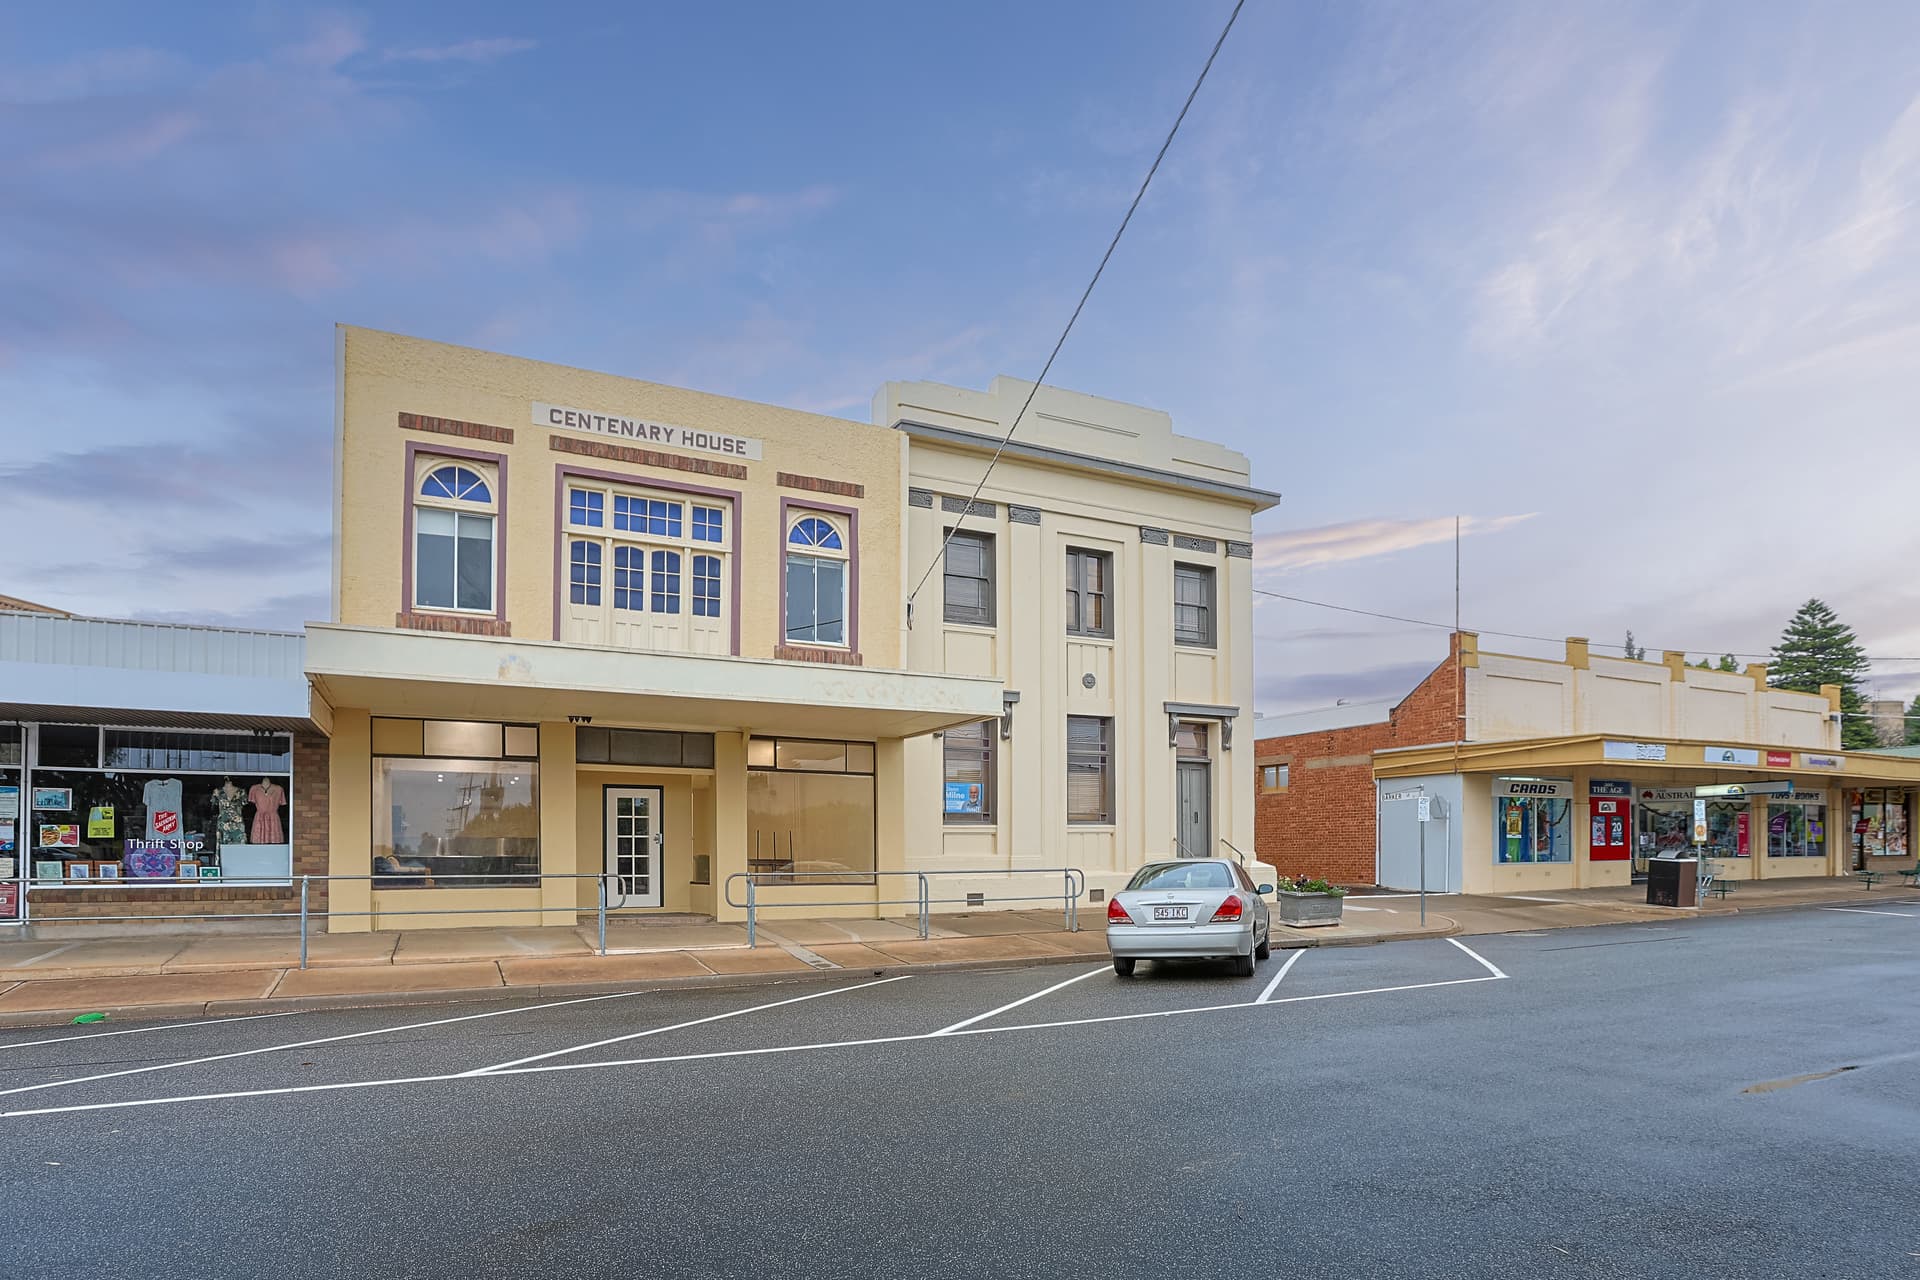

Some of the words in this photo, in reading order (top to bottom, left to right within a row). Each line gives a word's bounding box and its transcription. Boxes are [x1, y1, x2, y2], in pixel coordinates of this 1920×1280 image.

[549, 408, 674, 443] CENTENARY
[682, 430, 747, 455] HOUSE
[1510, 783, 1557, 794] CARDS
[1610, 786, 1625, 794] AGE
[1795, 792, 1820, 800] BOOKS
[158, 812, 168, 820] THE
[162, 820, 175, 832] ARMY
[1611, 822, 1622, 832] 20
[128, 838, 165, 849] Thrift
[169, 838, 204, 851] Shop
[1156, 909, 1169, 917] 545
